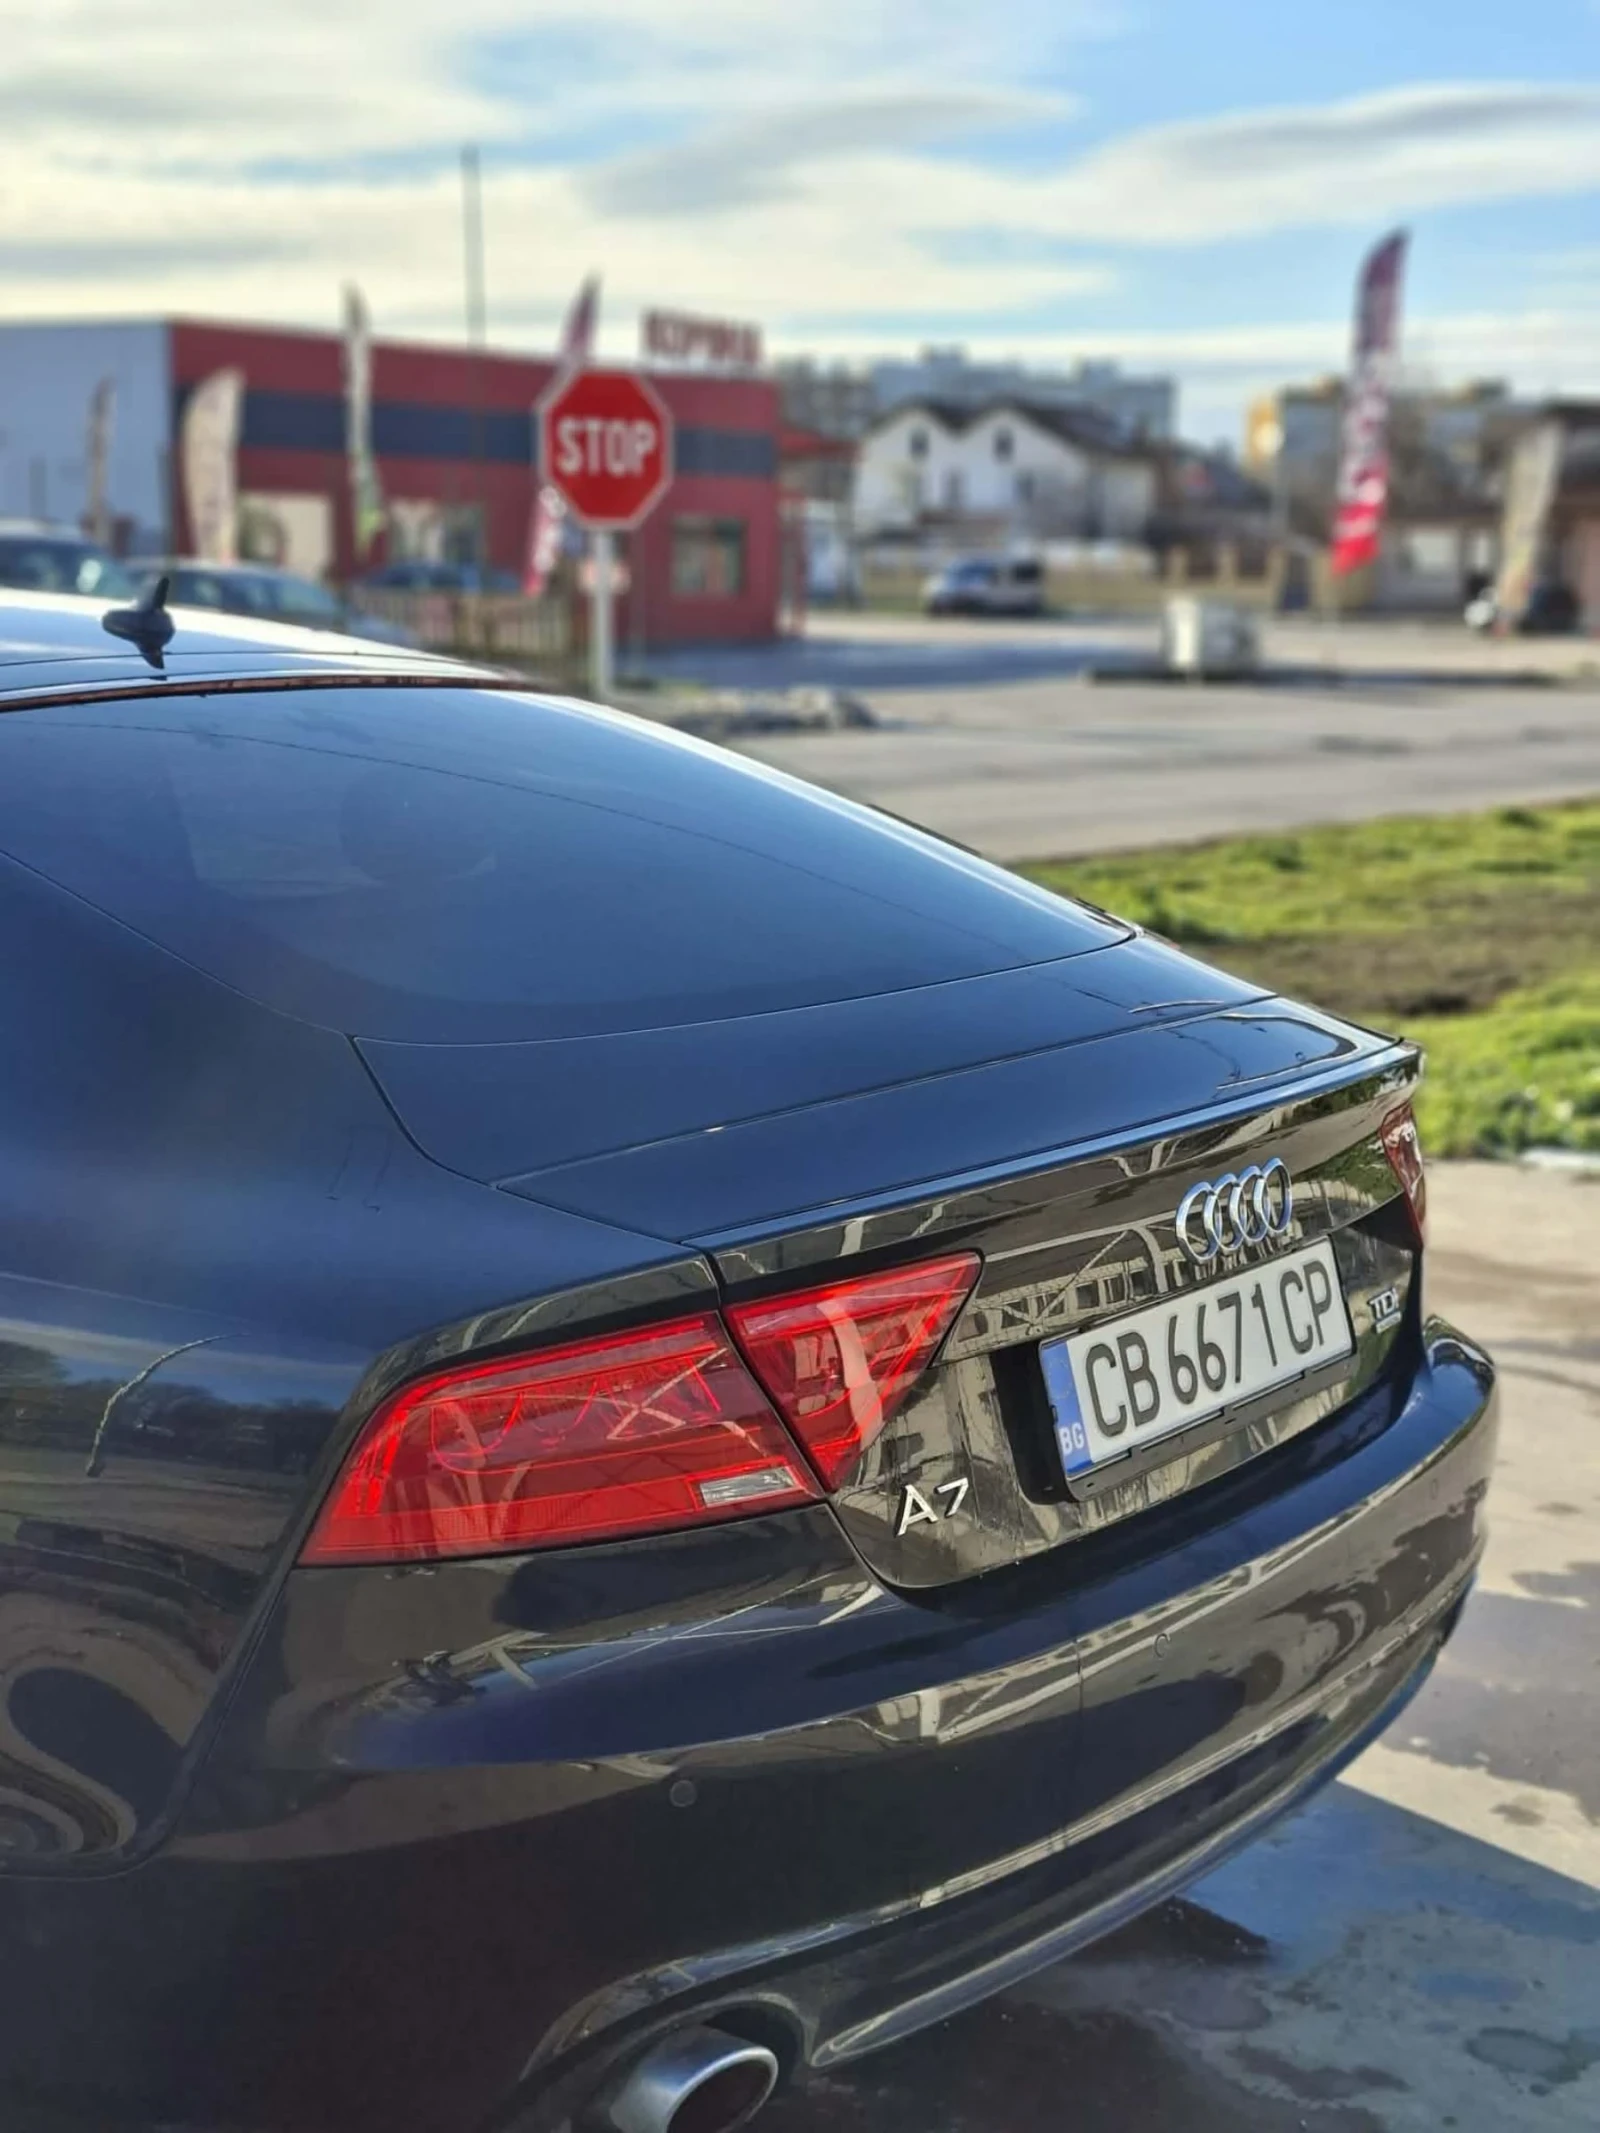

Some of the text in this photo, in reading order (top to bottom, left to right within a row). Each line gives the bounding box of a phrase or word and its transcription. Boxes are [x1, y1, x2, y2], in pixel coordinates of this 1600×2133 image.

[556, 416, 657, 476] STOP
[1086, 1260, 1332, 1437] CB 6671 CP
[1059, 1422, 1085, 1455] BG
[896, 1477, 969, 1536] A7
